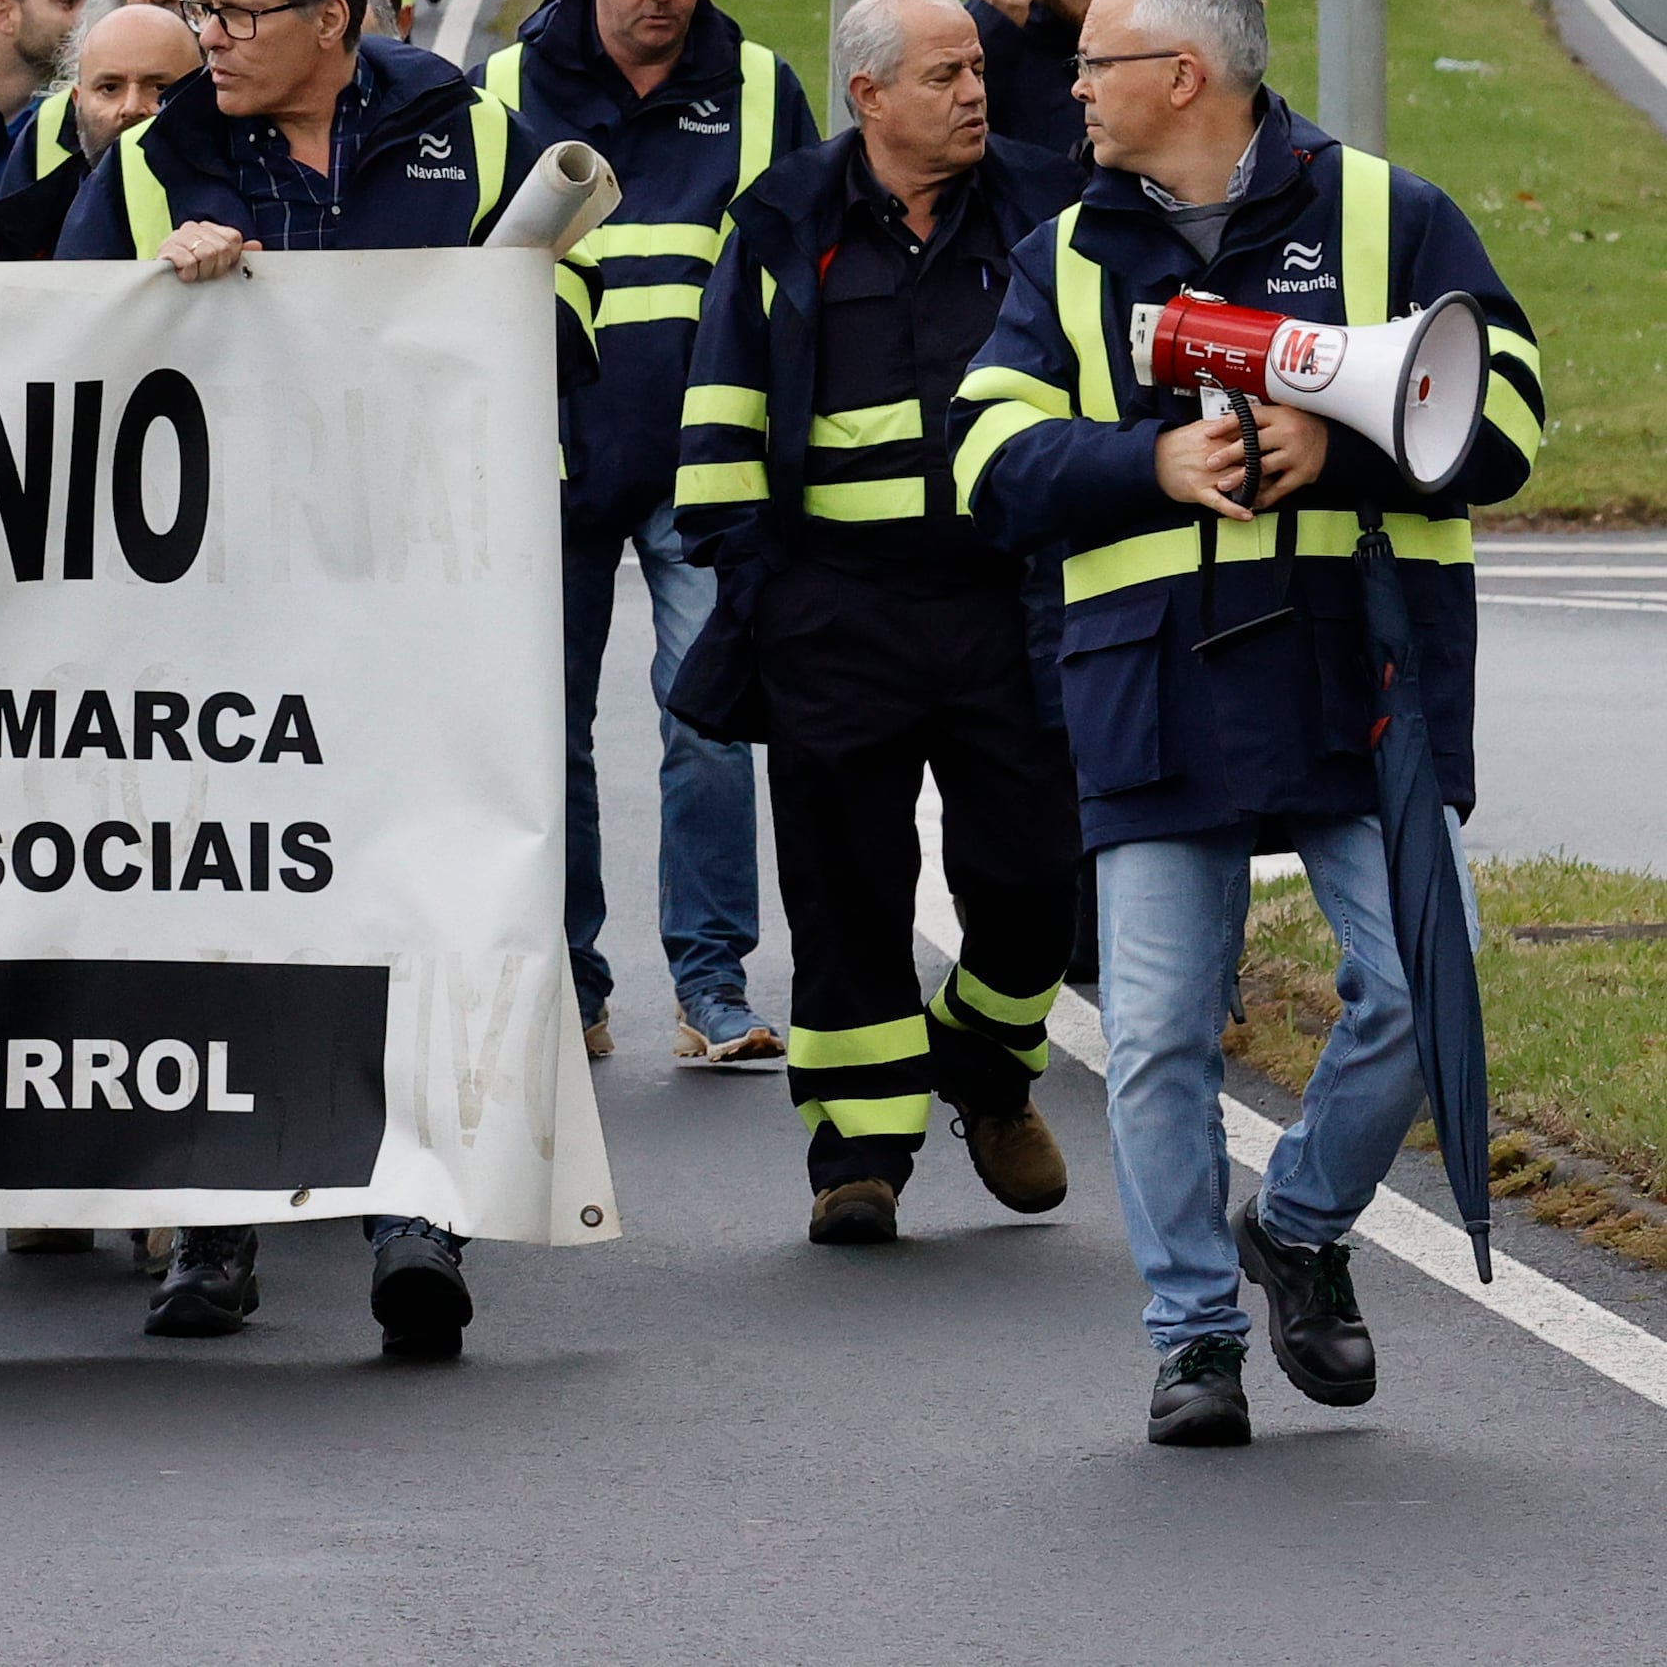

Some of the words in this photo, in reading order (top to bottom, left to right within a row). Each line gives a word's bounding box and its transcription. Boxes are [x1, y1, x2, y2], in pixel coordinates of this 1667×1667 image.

[679, 116, 731, 134] Navantia
[406, 163, 467, 181] Navantia
[1266, 273, 1337, 295] Navantia
